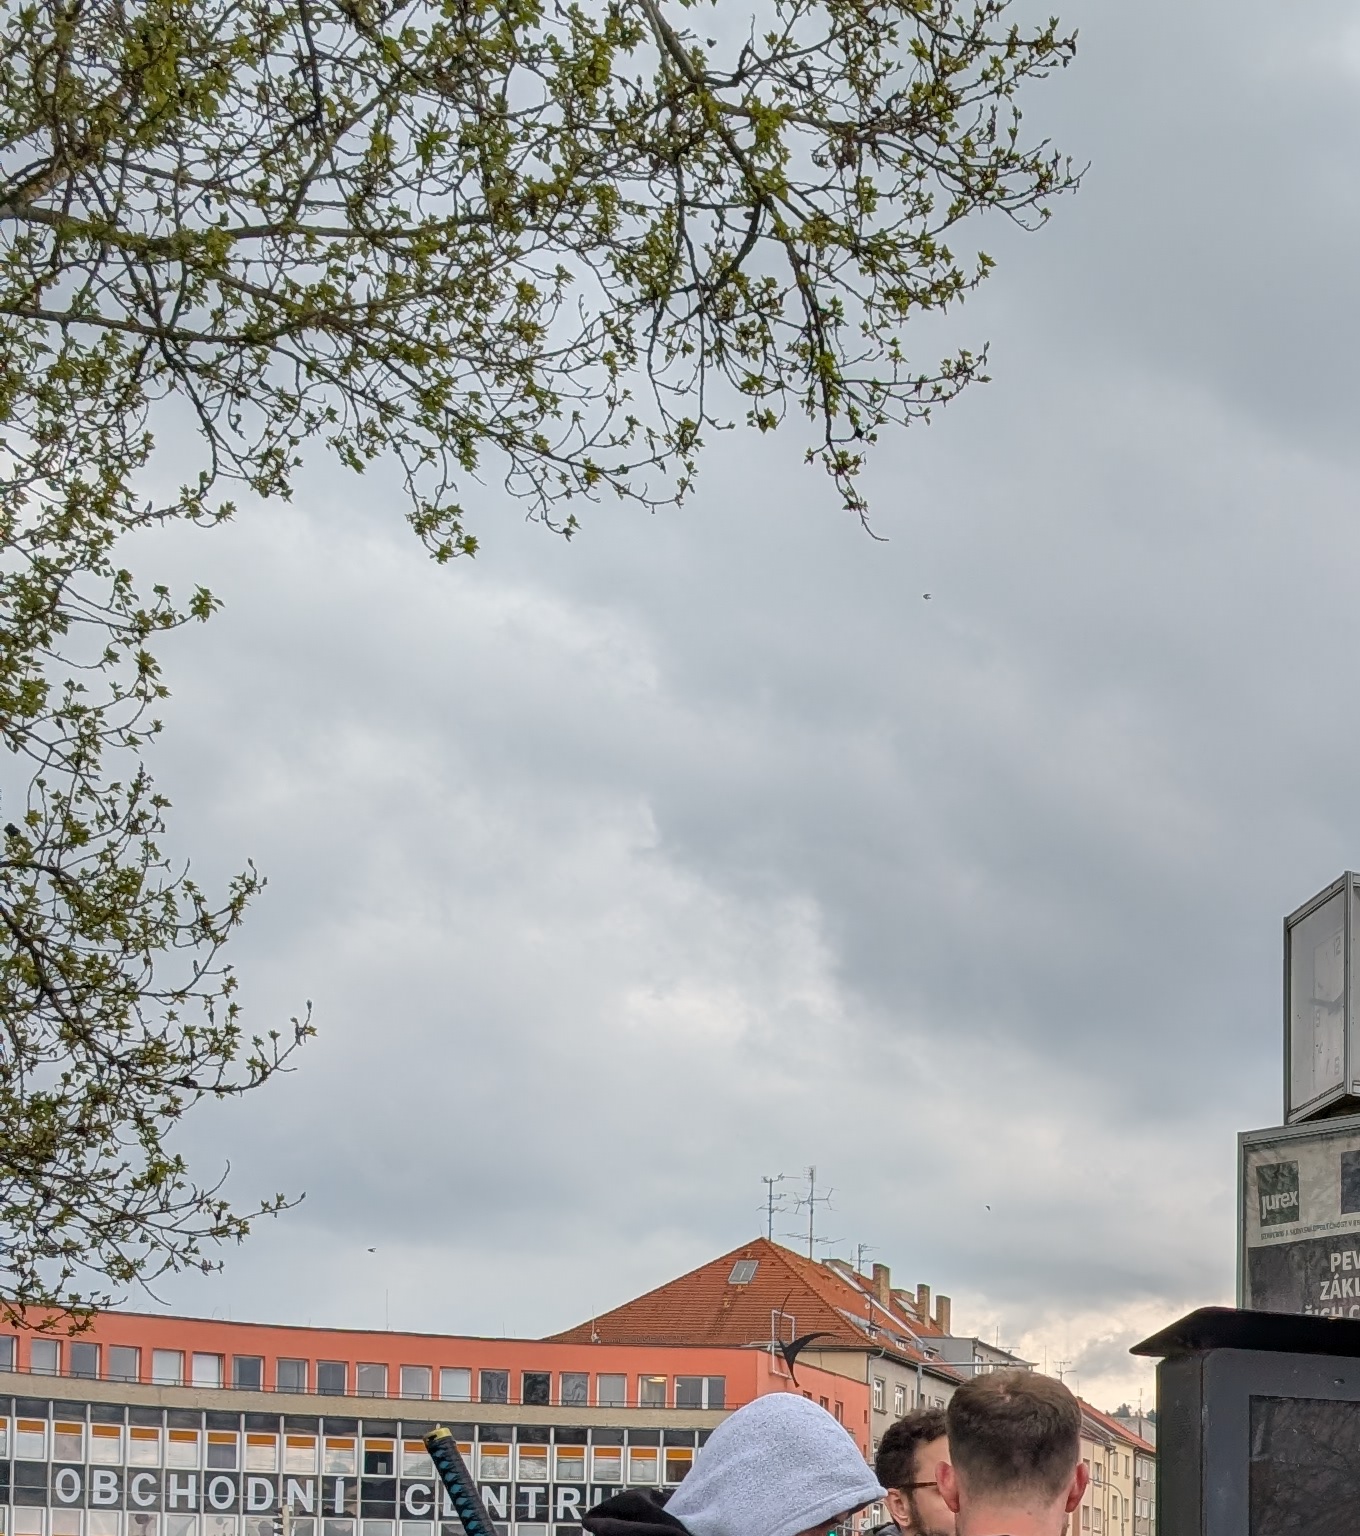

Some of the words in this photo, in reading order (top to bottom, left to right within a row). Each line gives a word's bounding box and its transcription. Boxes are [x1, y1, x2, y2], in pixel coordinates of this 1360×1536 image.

[1261, 1190, 1299, 1220] jurex
[55, 1467, 345, 1514] OBCHODNÍ
[404, 1483, 616, 1520] CNTR
